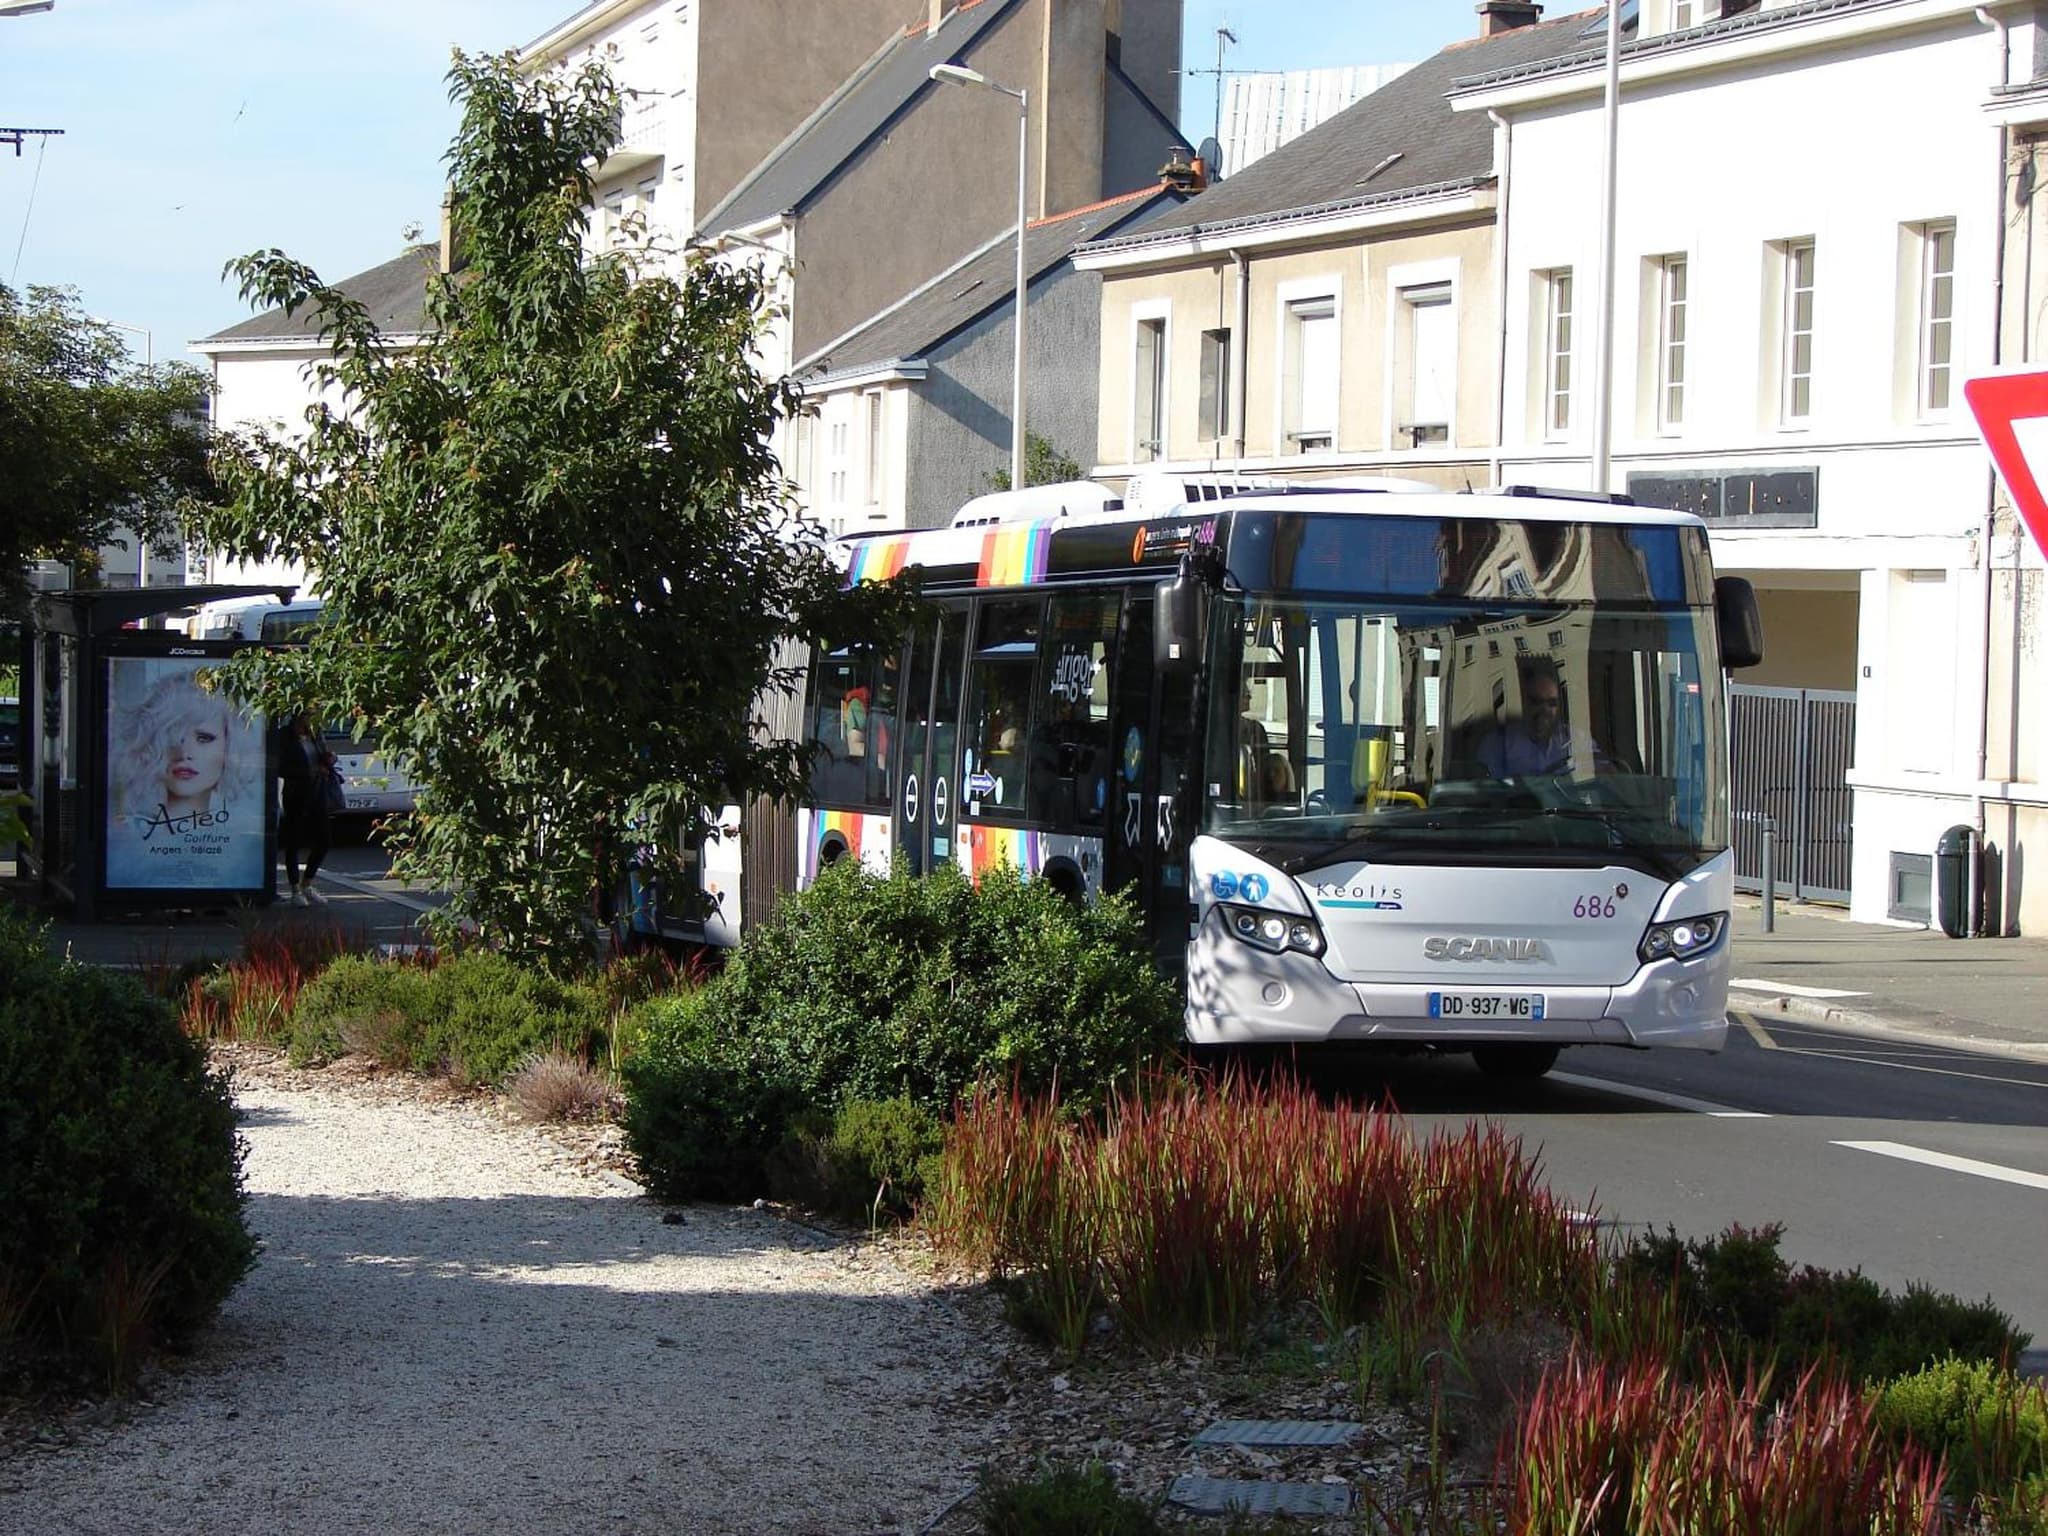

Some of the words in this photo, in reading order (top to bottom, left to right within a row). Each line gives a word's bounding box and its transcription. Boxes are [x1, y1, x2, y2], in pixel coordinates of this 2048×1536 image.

[1316, 882, 1402, 899] Keolis
[1573, 895, 1616, 918] 686
[1424, 937, 1545, 962] SCANIA
